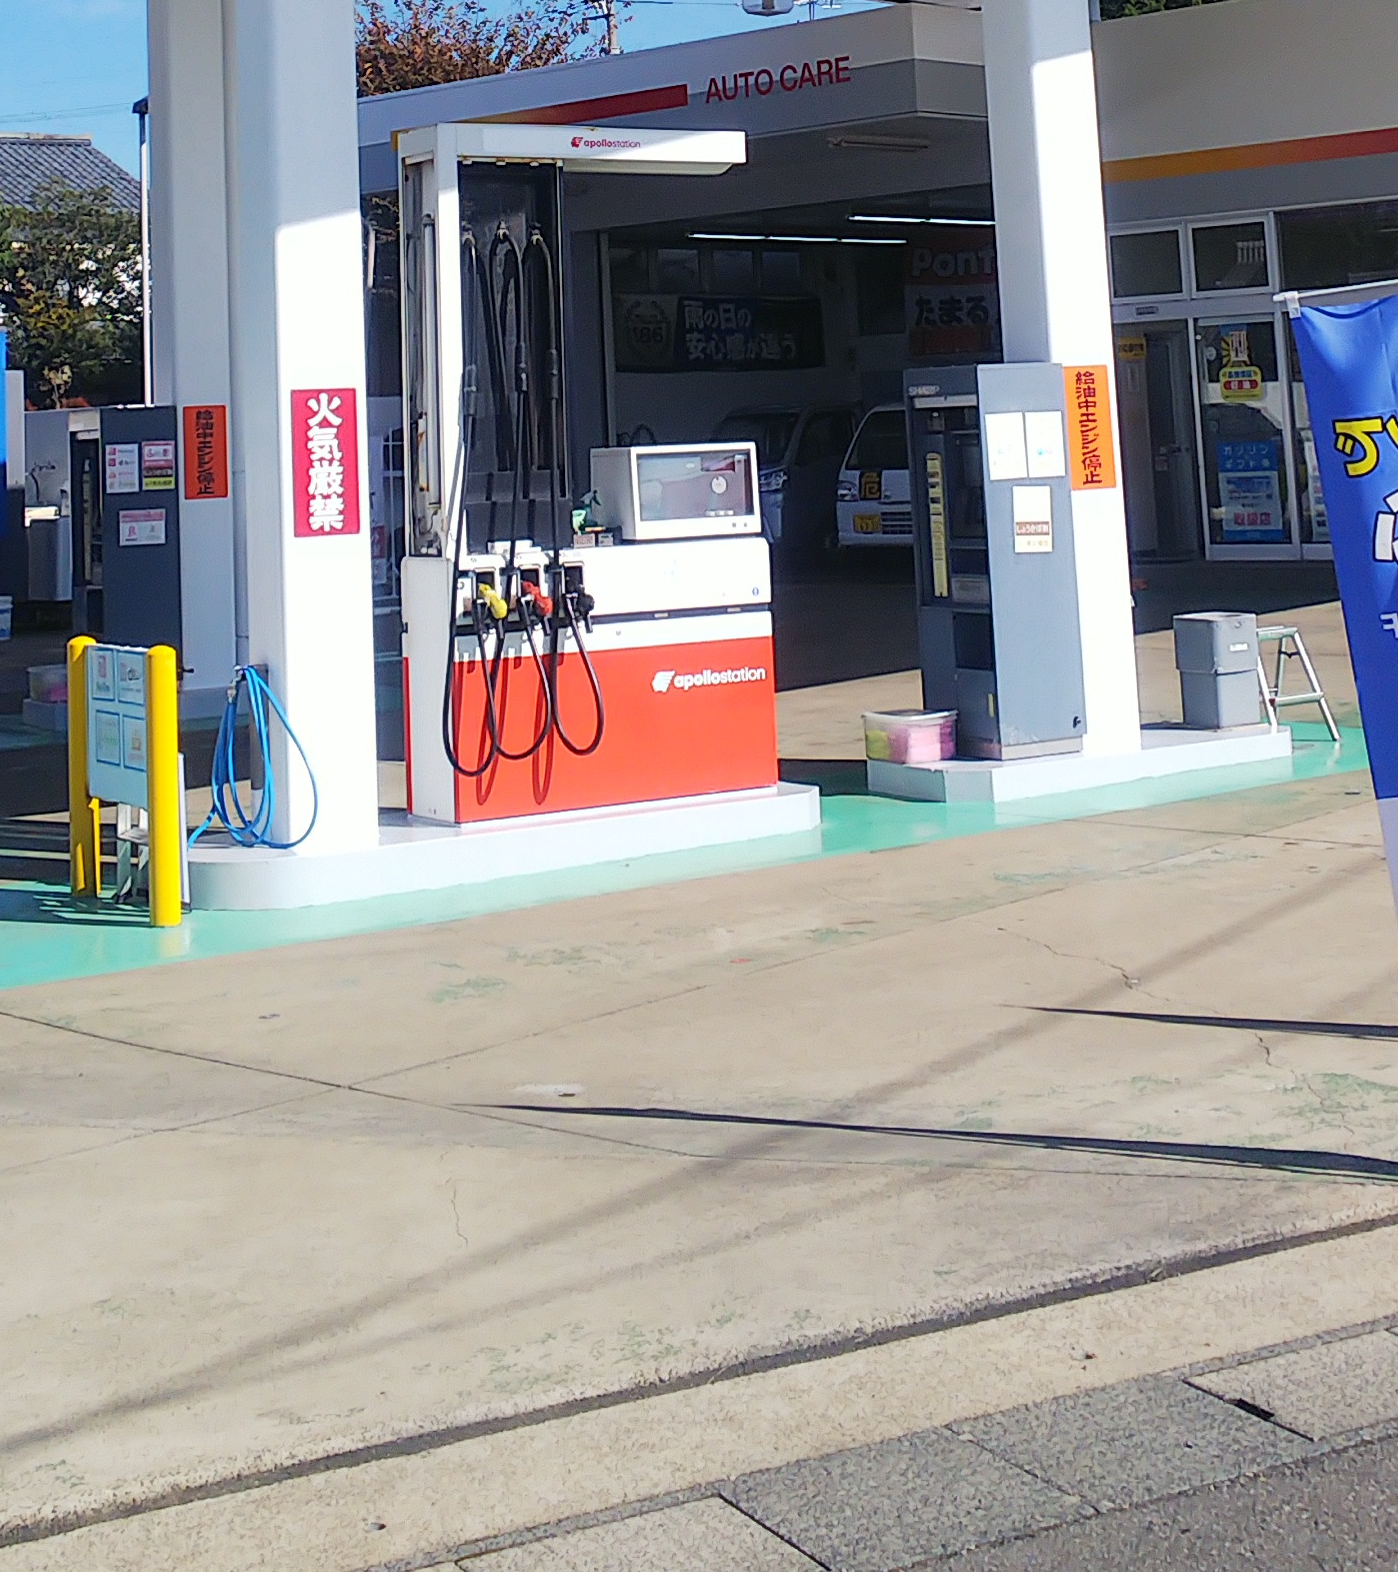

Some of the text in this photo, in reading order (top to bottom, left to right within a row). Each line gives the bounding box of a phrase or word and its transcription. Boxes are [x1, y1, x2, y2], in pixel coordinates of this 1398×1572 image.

[705, 56, 852, 104] AUTO CARE
[584, 139, 641, 149] apollostation
[911, 247, 996, 277] Pont
[1074, 370, 1103, 486] 給油中エンジン停止
[306, 393, 345, 532] 火気厳禁
[674, 665, 766, 691] apollostation
